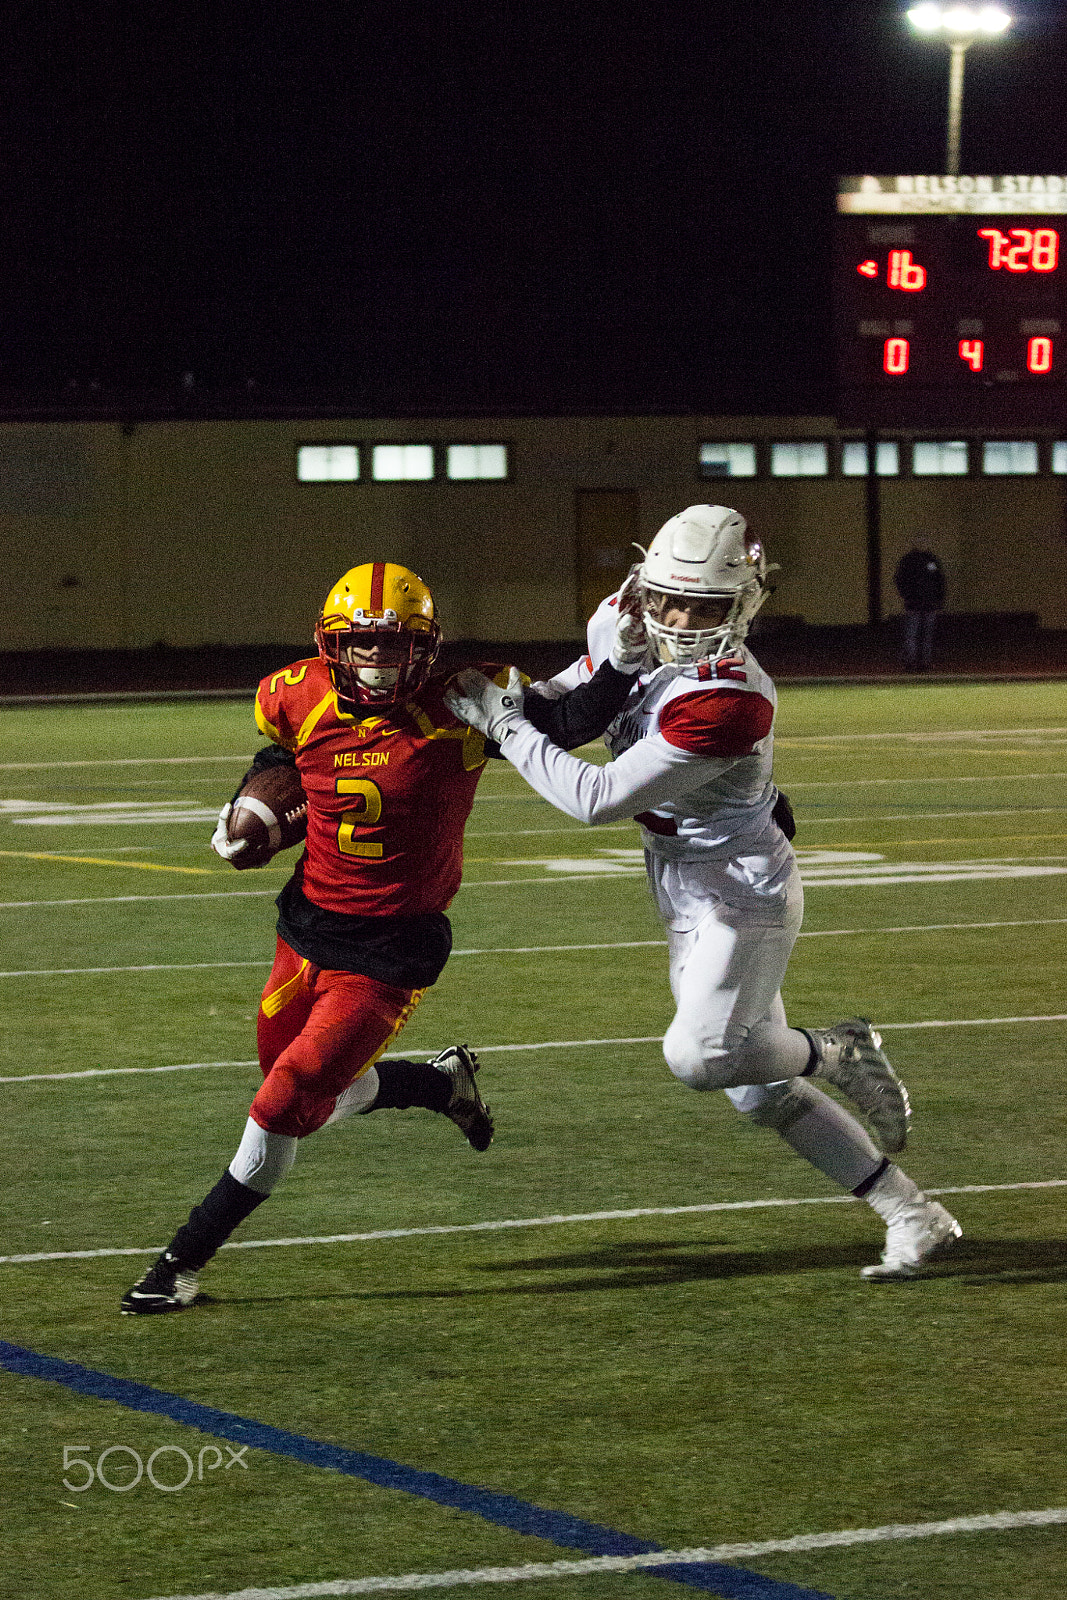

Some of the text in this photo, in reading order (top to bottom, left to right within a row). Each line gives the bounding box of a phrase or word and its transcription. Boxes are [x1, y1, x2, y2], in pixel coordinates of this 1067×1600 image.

[897, 175, 1067, 193] NELSON STAD
[977, 228, 1060, 273] 7:28
[887, 250, 927, 292] 16
[883, 338, 910, 375] 0
[958, 340, 984, 372] 4
[1027, 337, 1053, 374] 0
[269, 665, 308, 693] 2
[358, 728, 366, 738] N
[334, 752, 390, 768] NELSON
[335, 777, 383, 858] 2
